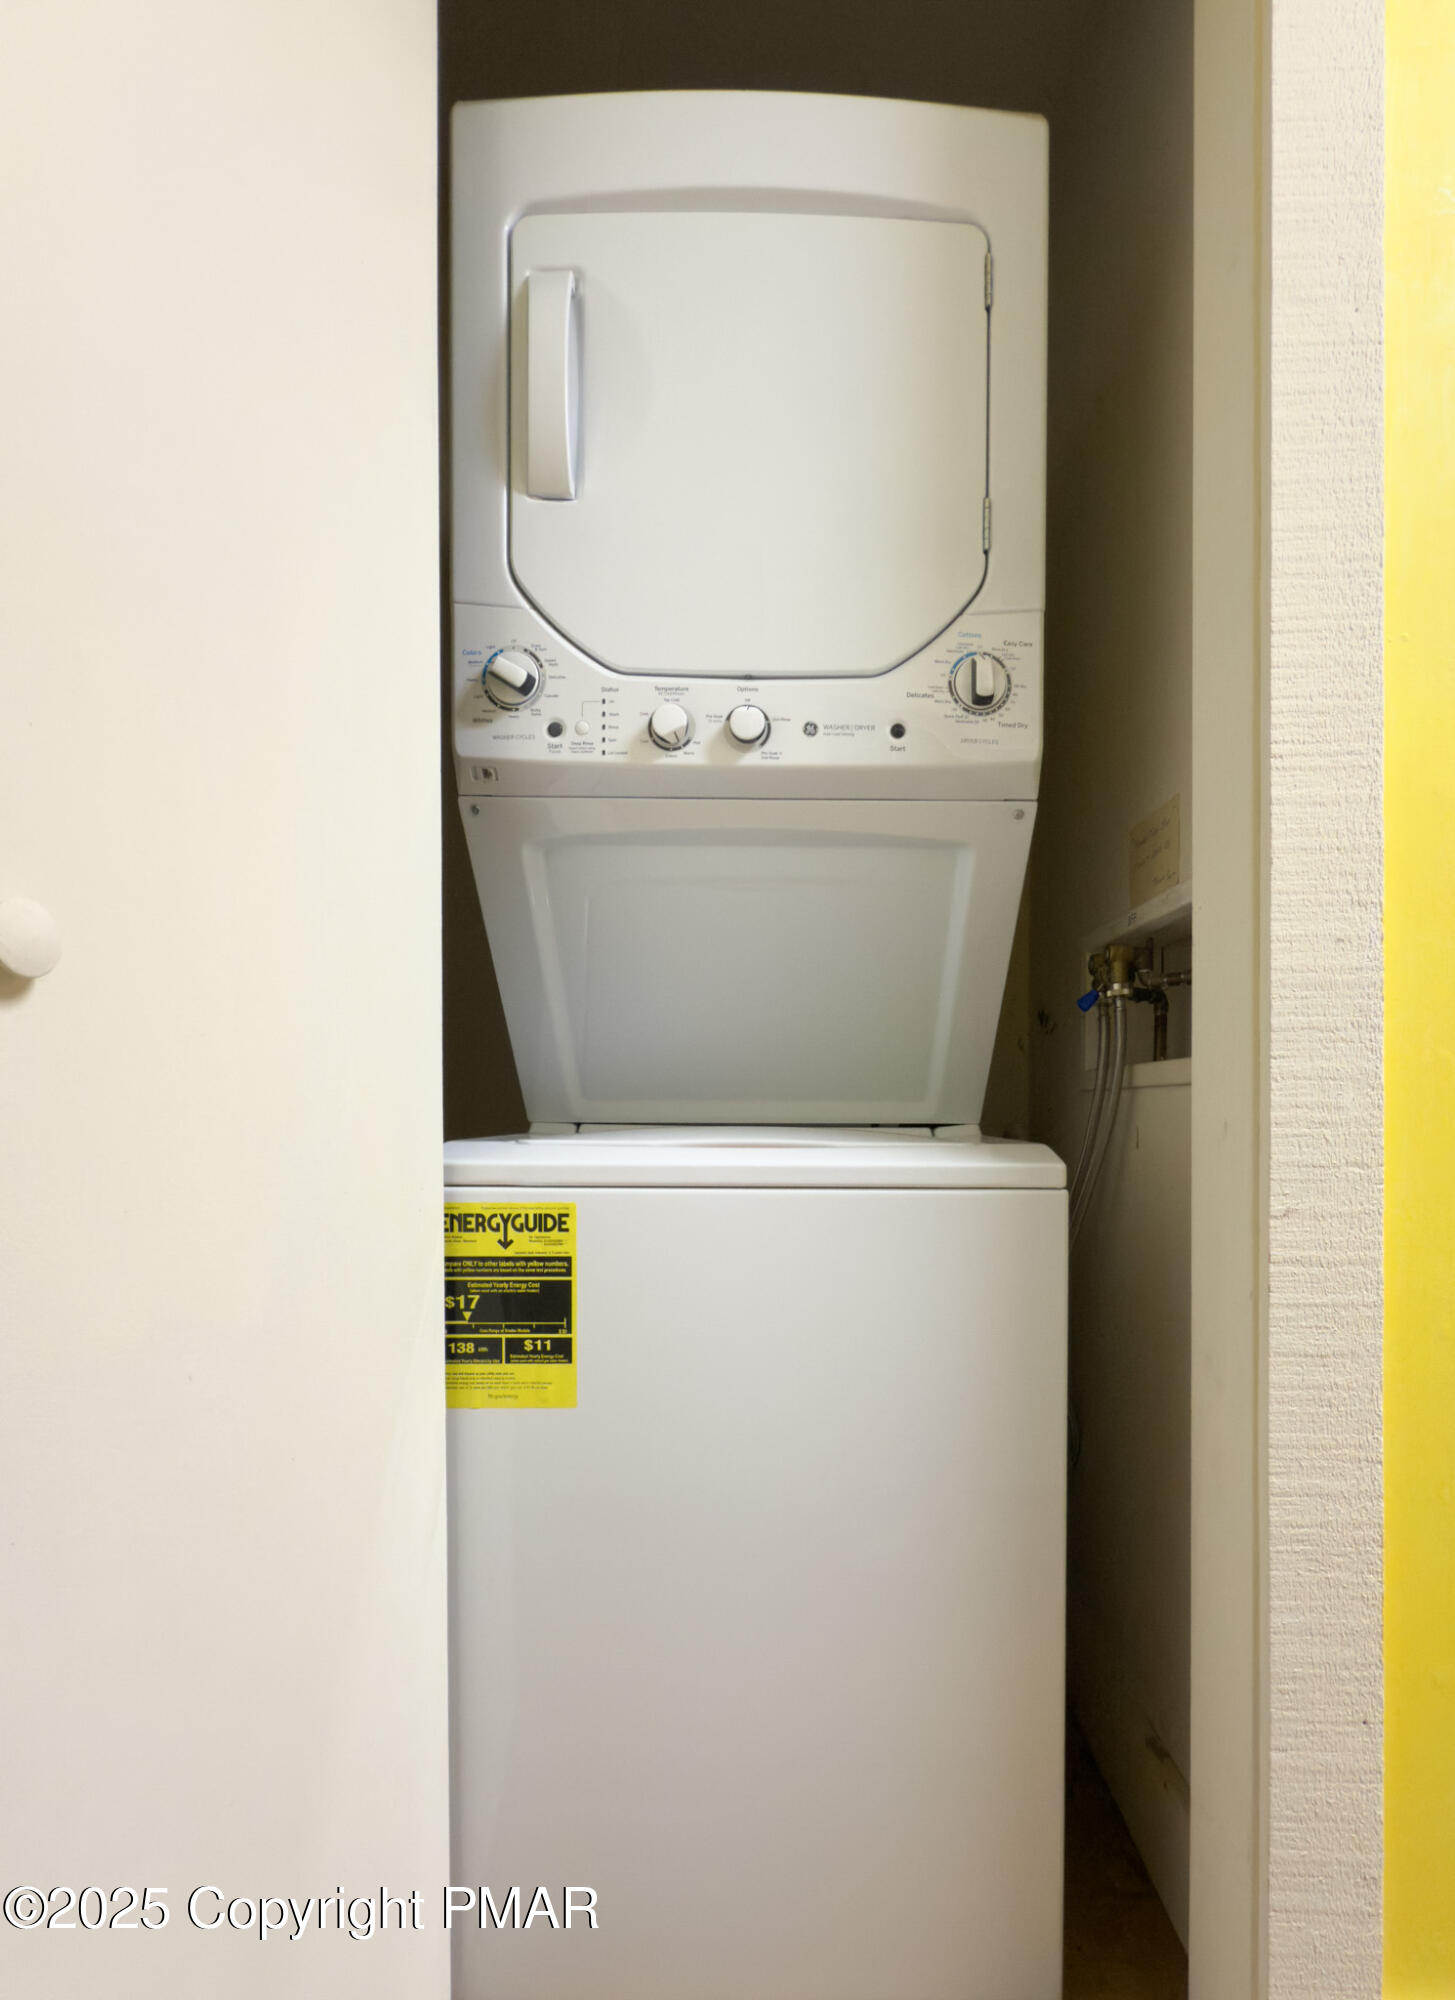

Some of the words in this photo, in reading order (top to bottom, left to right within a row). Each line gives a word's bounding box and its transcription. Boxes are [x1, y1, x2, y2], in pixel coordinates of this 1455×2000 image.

[444, 1295, 480, 1310] $17
[448, 1342, 474, 1354] 138
[524, 1339, 552, 1352] $11
